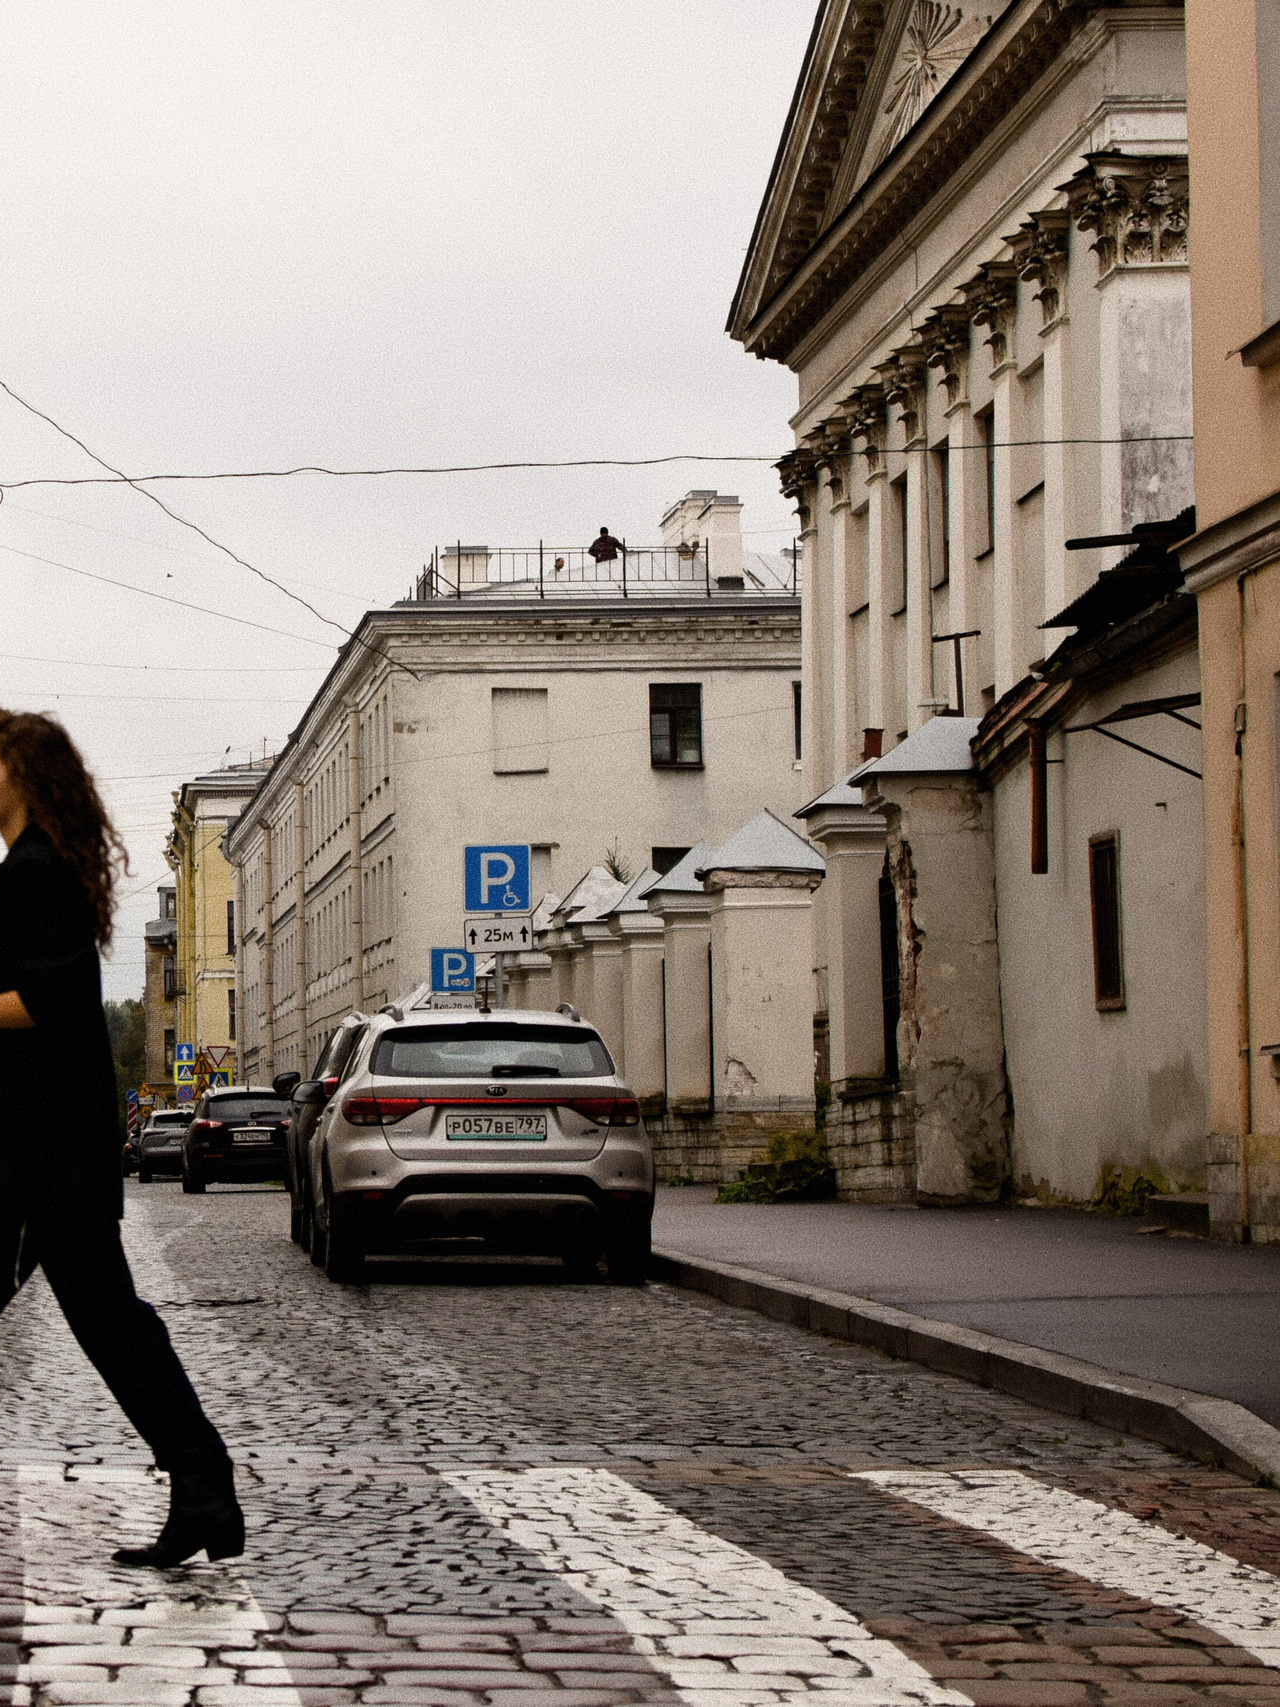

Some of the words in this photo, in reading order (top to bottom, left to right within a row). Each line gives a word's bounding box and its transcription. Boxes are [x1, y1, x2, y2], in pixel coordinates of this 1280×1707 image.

[480, 852, 516, 904] P
[484, 928, 514, 943] 25м
[443, 952, 467, 988] P
[488, 1086, 505, 1094] KIA
[452, 1118, 514, 1134] Р057ВЕ
[518, 1118, 541, 1130] 797
